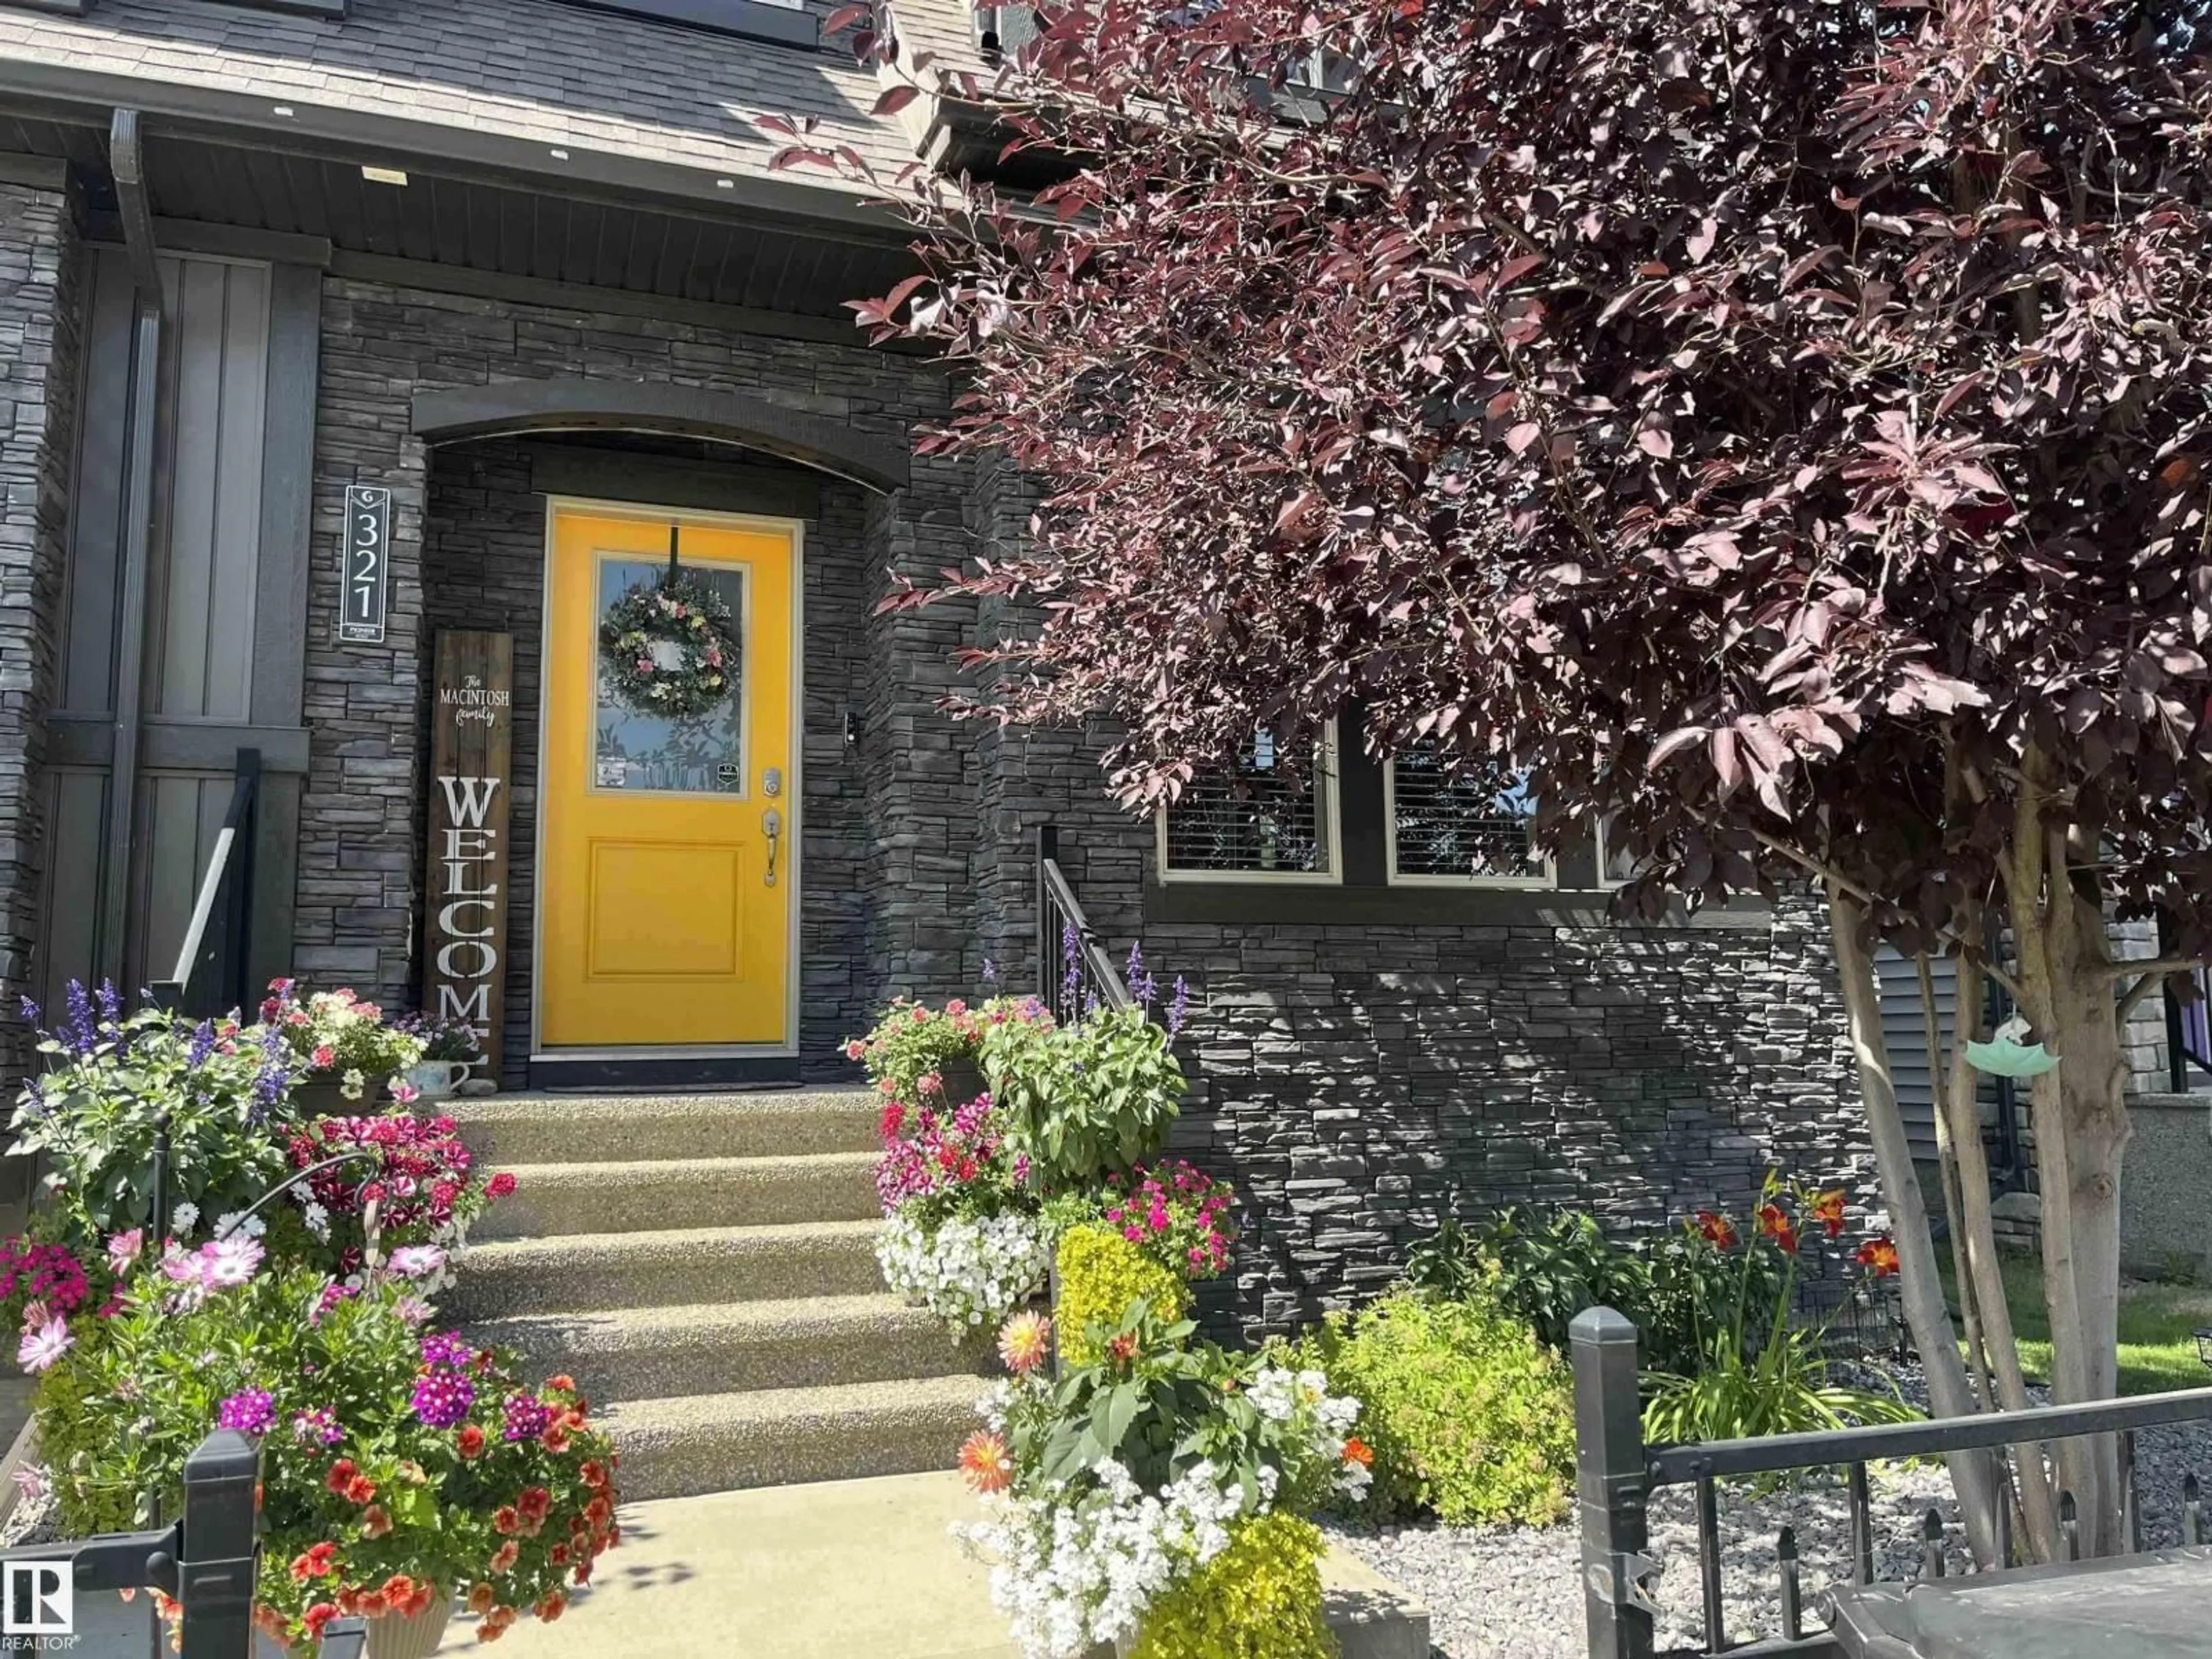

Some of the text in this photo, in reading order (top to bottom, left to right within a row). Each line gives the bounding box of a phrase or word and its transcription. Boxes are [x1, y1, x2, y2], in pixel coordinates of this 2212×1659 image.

[353, 514, 378, 618] 321
[464, 674, 482, 688] The
[440, 688, 510, 706] MACINTOSH
[456, 706, 495, 728] family
